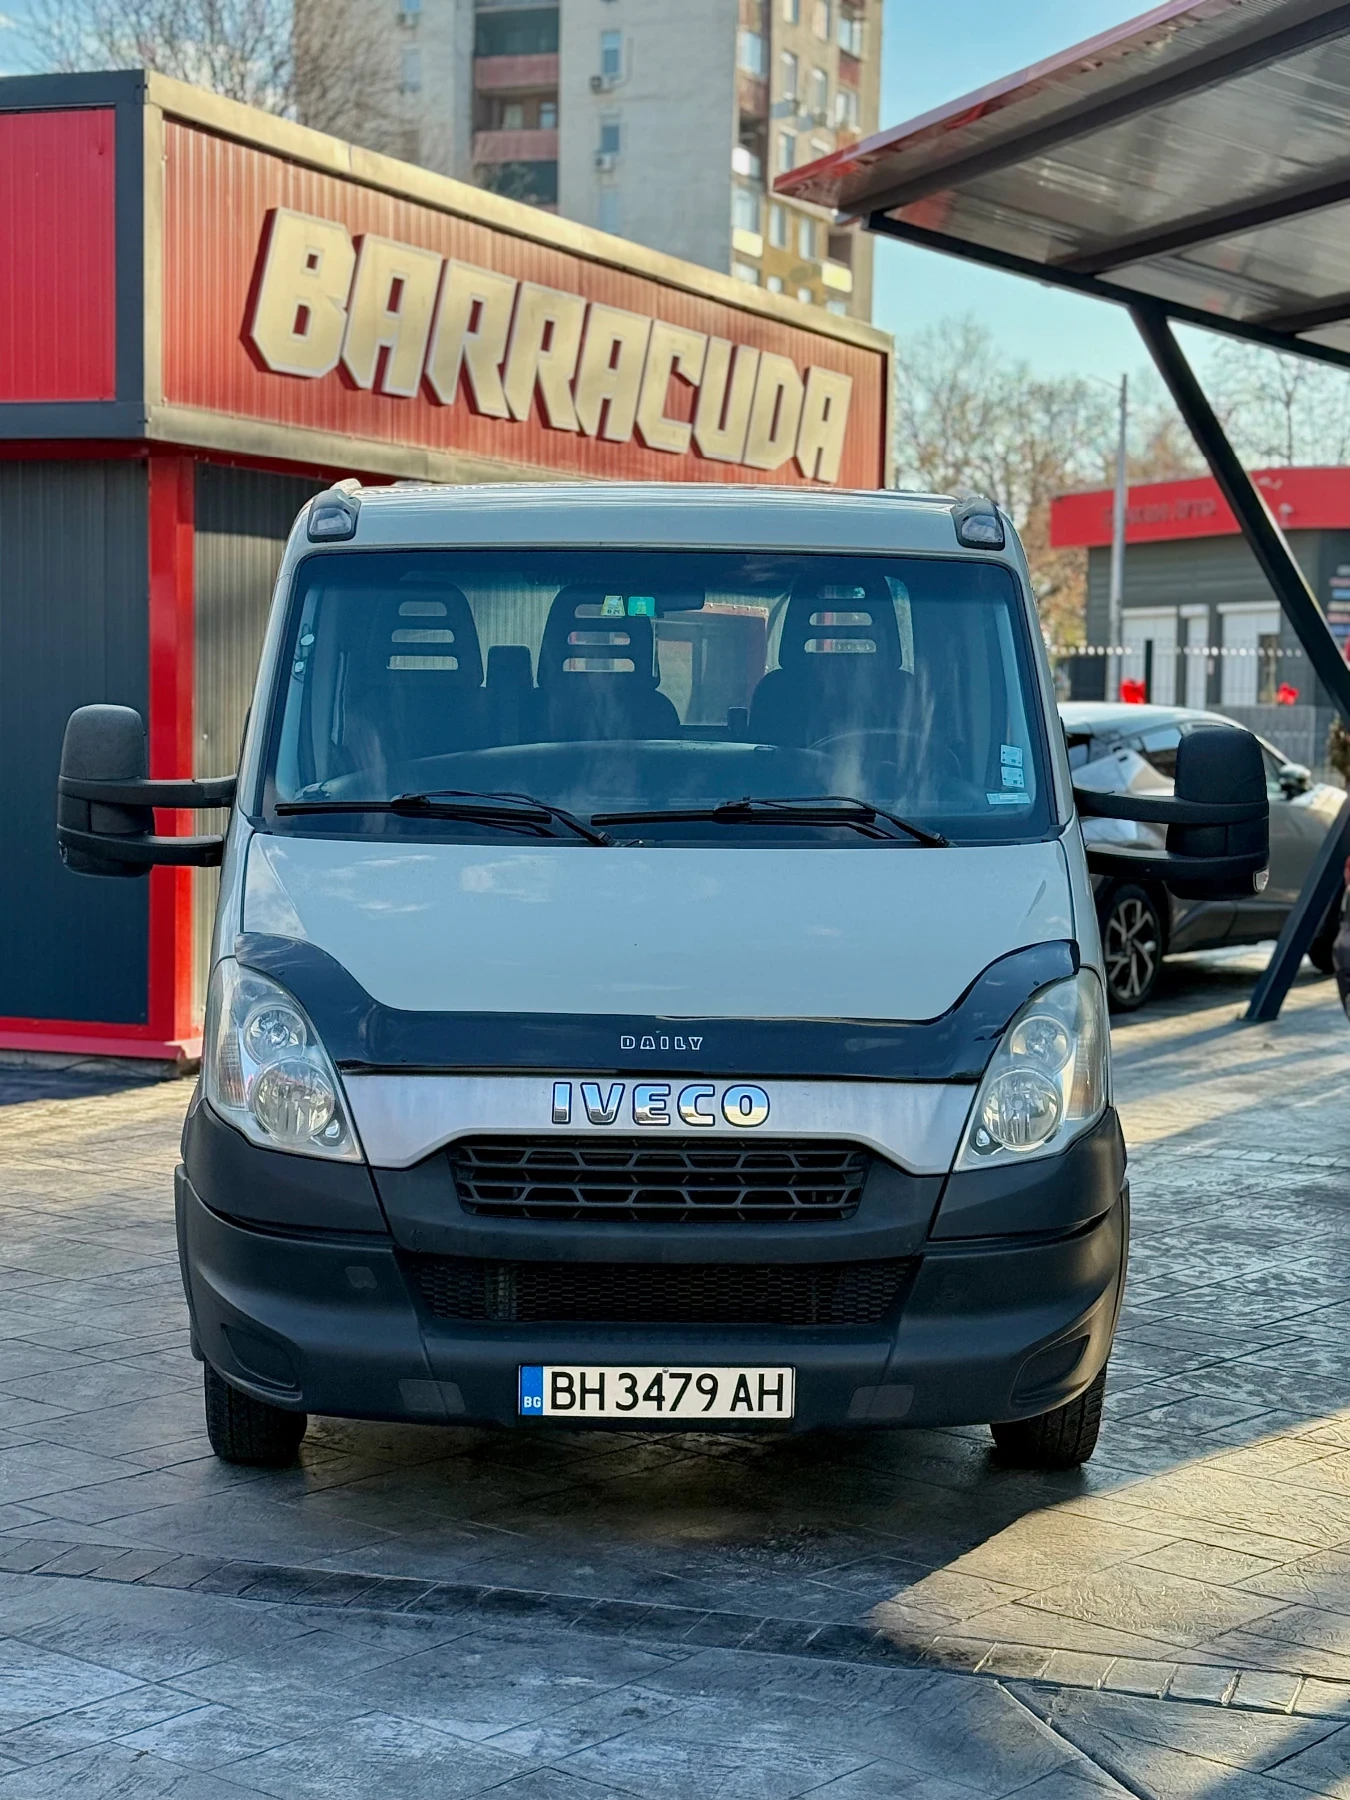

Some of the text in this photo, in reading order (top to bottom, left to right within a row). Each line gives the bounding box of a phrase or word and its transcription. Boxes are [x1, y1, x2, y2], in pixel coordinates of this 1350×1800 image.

[243, 206, 854, 485] BARRACUDA
[620, 1035, 703, 1051] DAILY
[551, 1081, 771, 1128] IVECO
[523, 1396, 542, 1409] BG
[550, 1371, 784, 1412] BH 3479 AH
